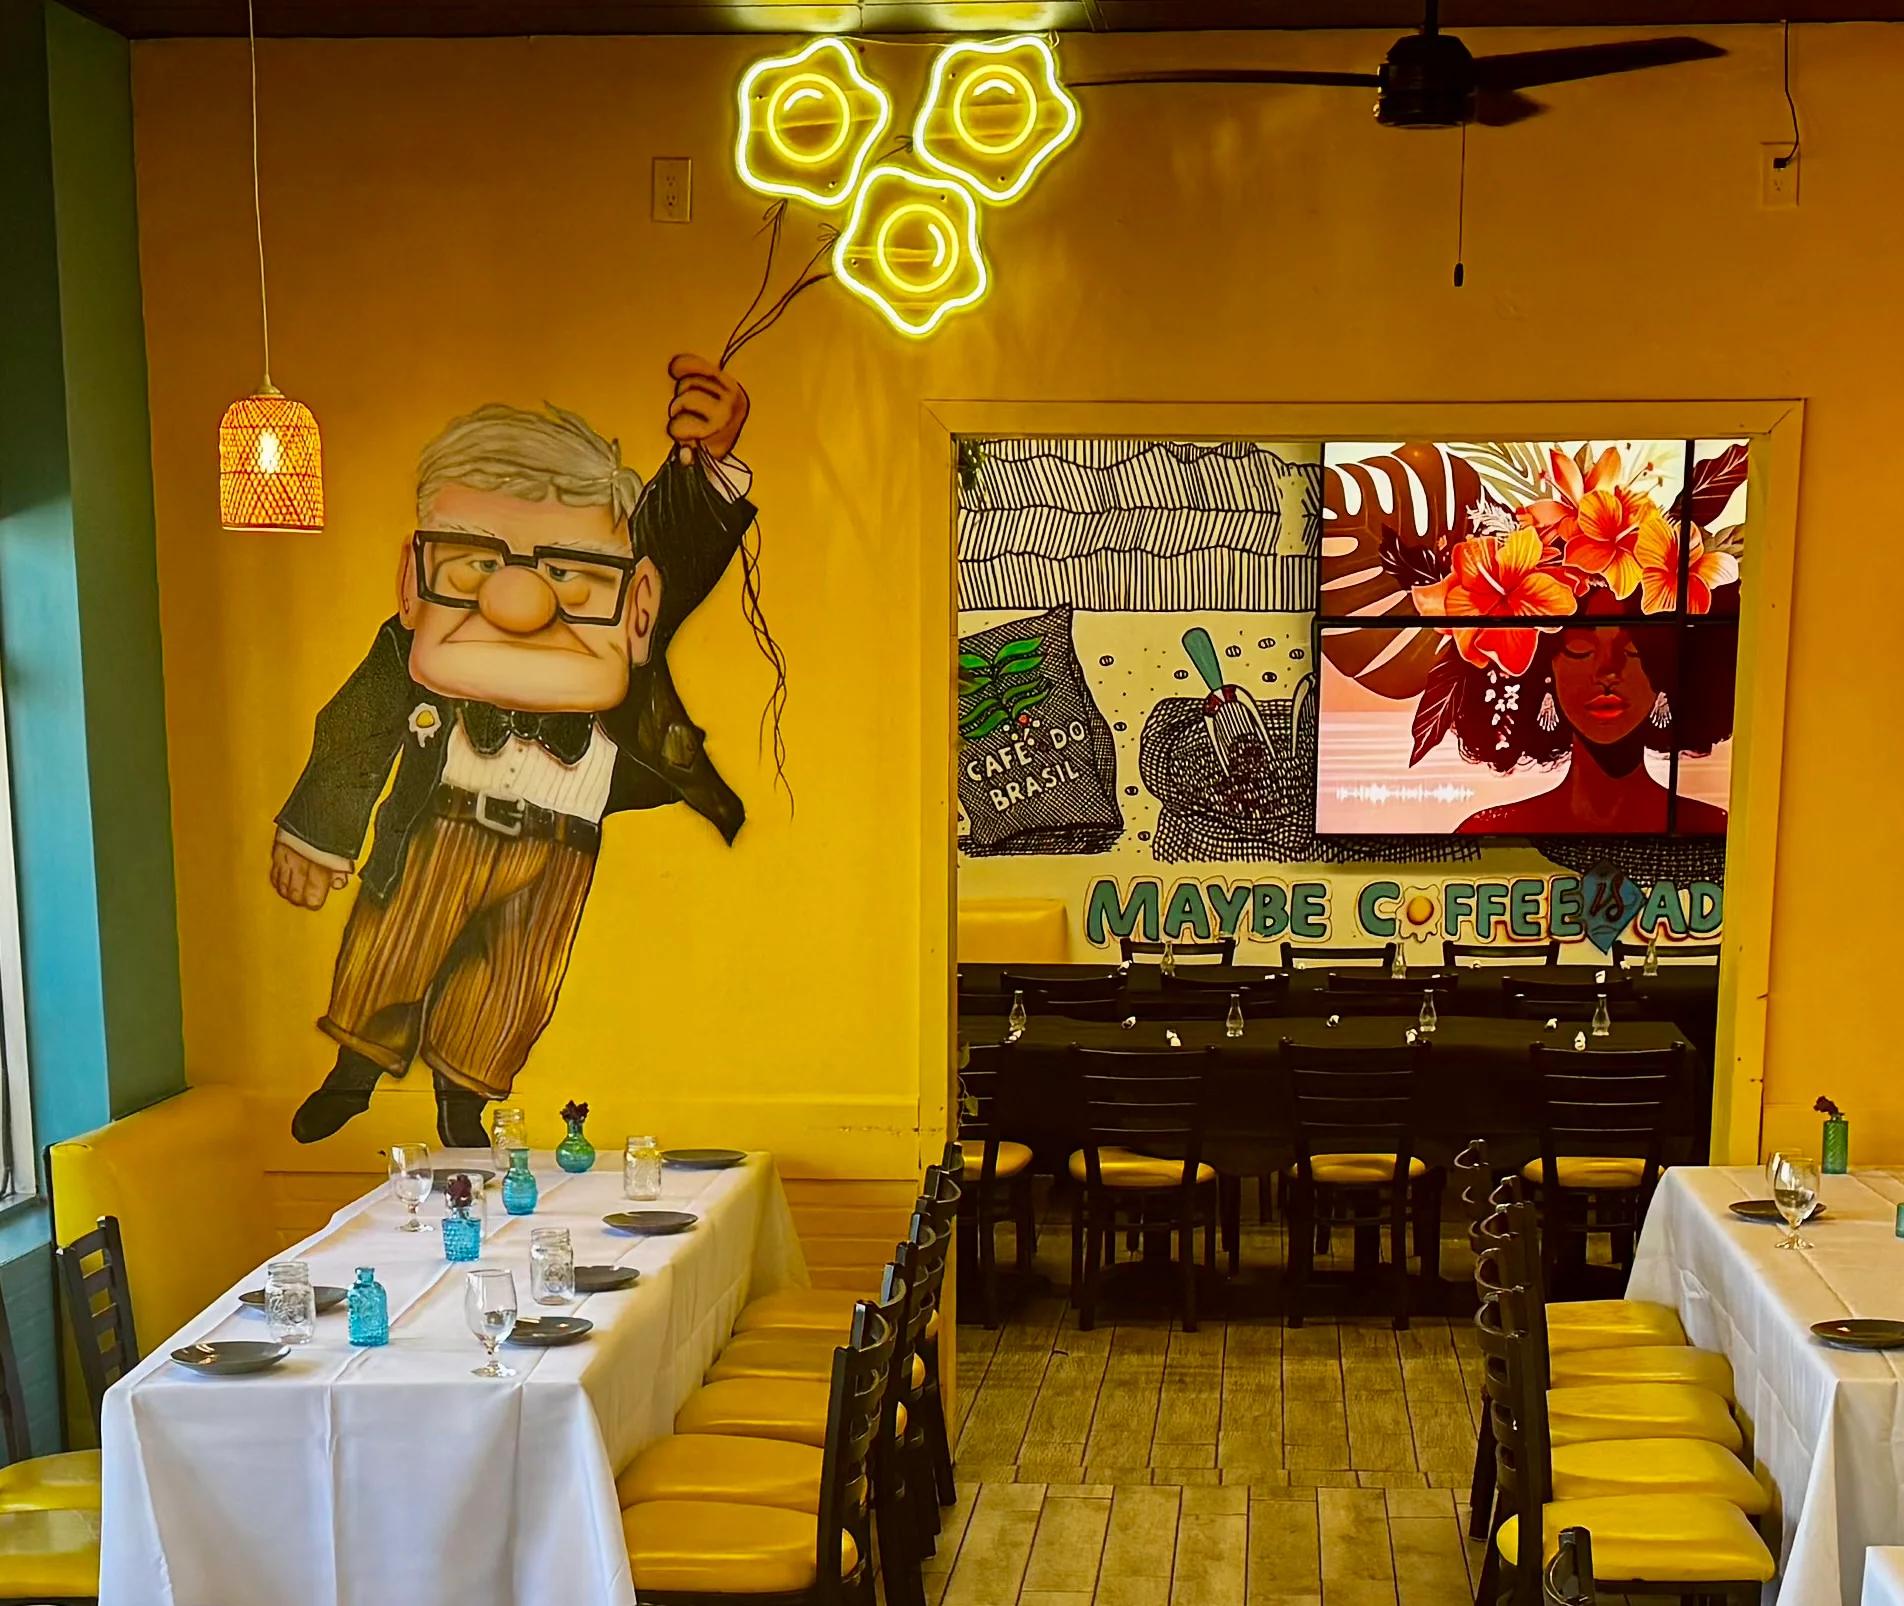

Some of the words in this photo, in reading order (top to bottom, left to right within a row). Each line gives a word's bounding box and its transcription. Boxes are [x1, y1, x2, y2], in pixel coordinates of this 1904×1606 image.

[1050, 721, 1085, 750] DO
[989, 761, 1079, 811] BRASIL
[1085, 878, 1328, 944] MAYBE
